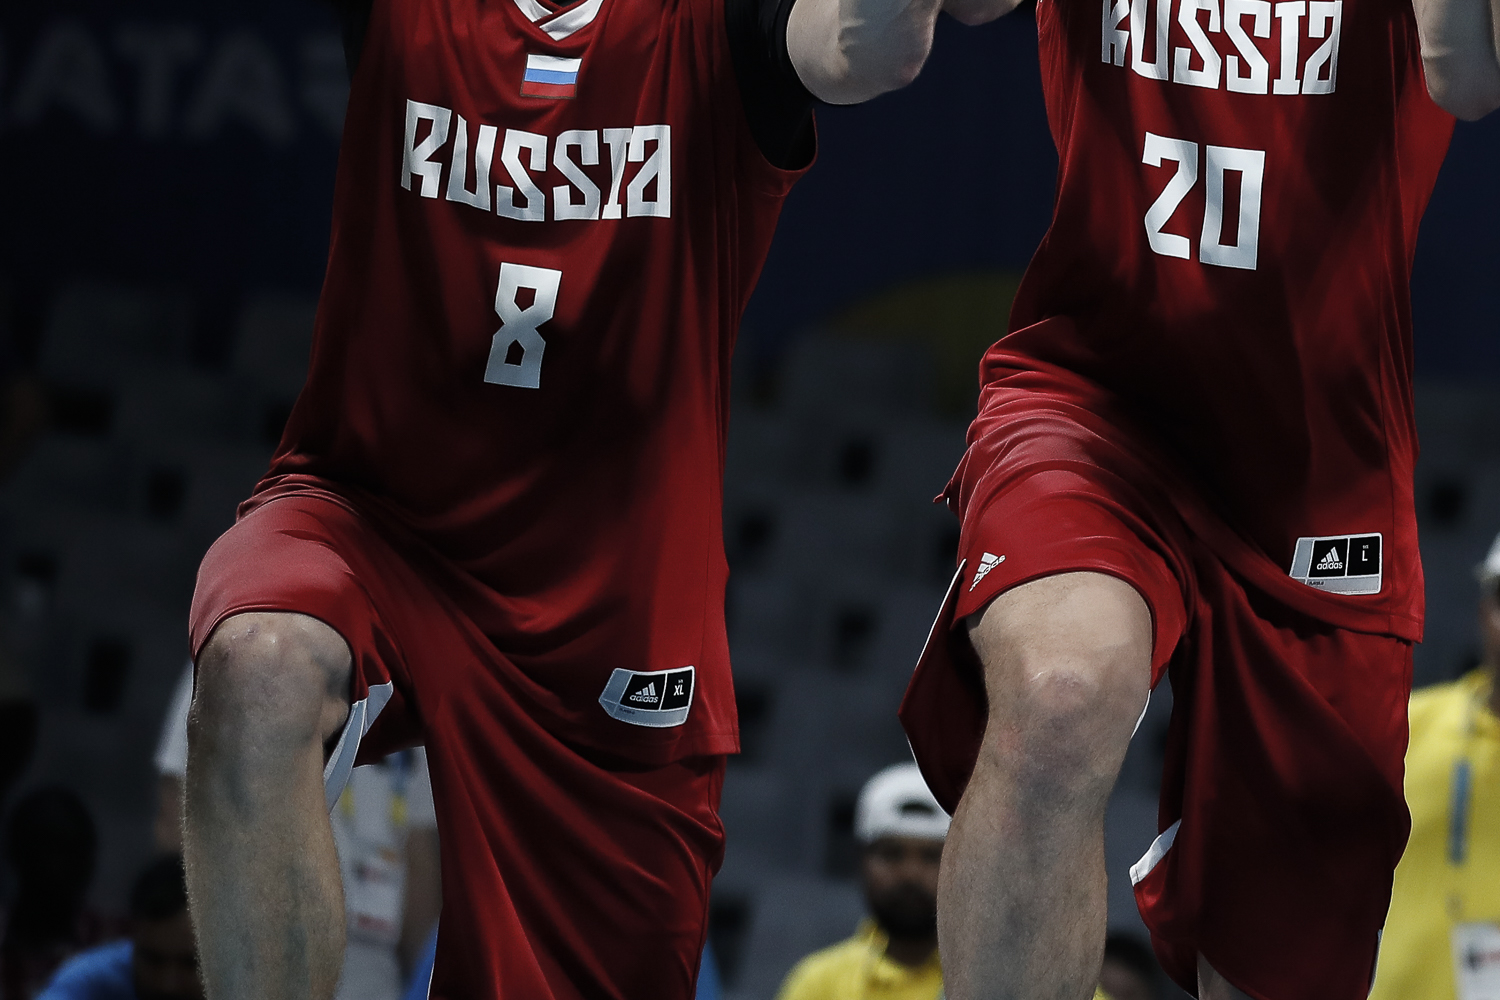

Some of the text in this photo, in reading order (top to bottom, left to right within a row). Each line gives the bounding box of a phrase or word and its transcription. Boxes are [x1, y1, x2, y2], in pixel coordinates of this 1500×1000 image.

[400, 98, 671, 222] RUSSIA
[1141, 132, 1266, 270] 20
[483, 262, 562, 389] 8
[1362, 550, 1368, 561] L
[629, 694, 658, 703] adidas
[673, 684, 684, 696] XL
